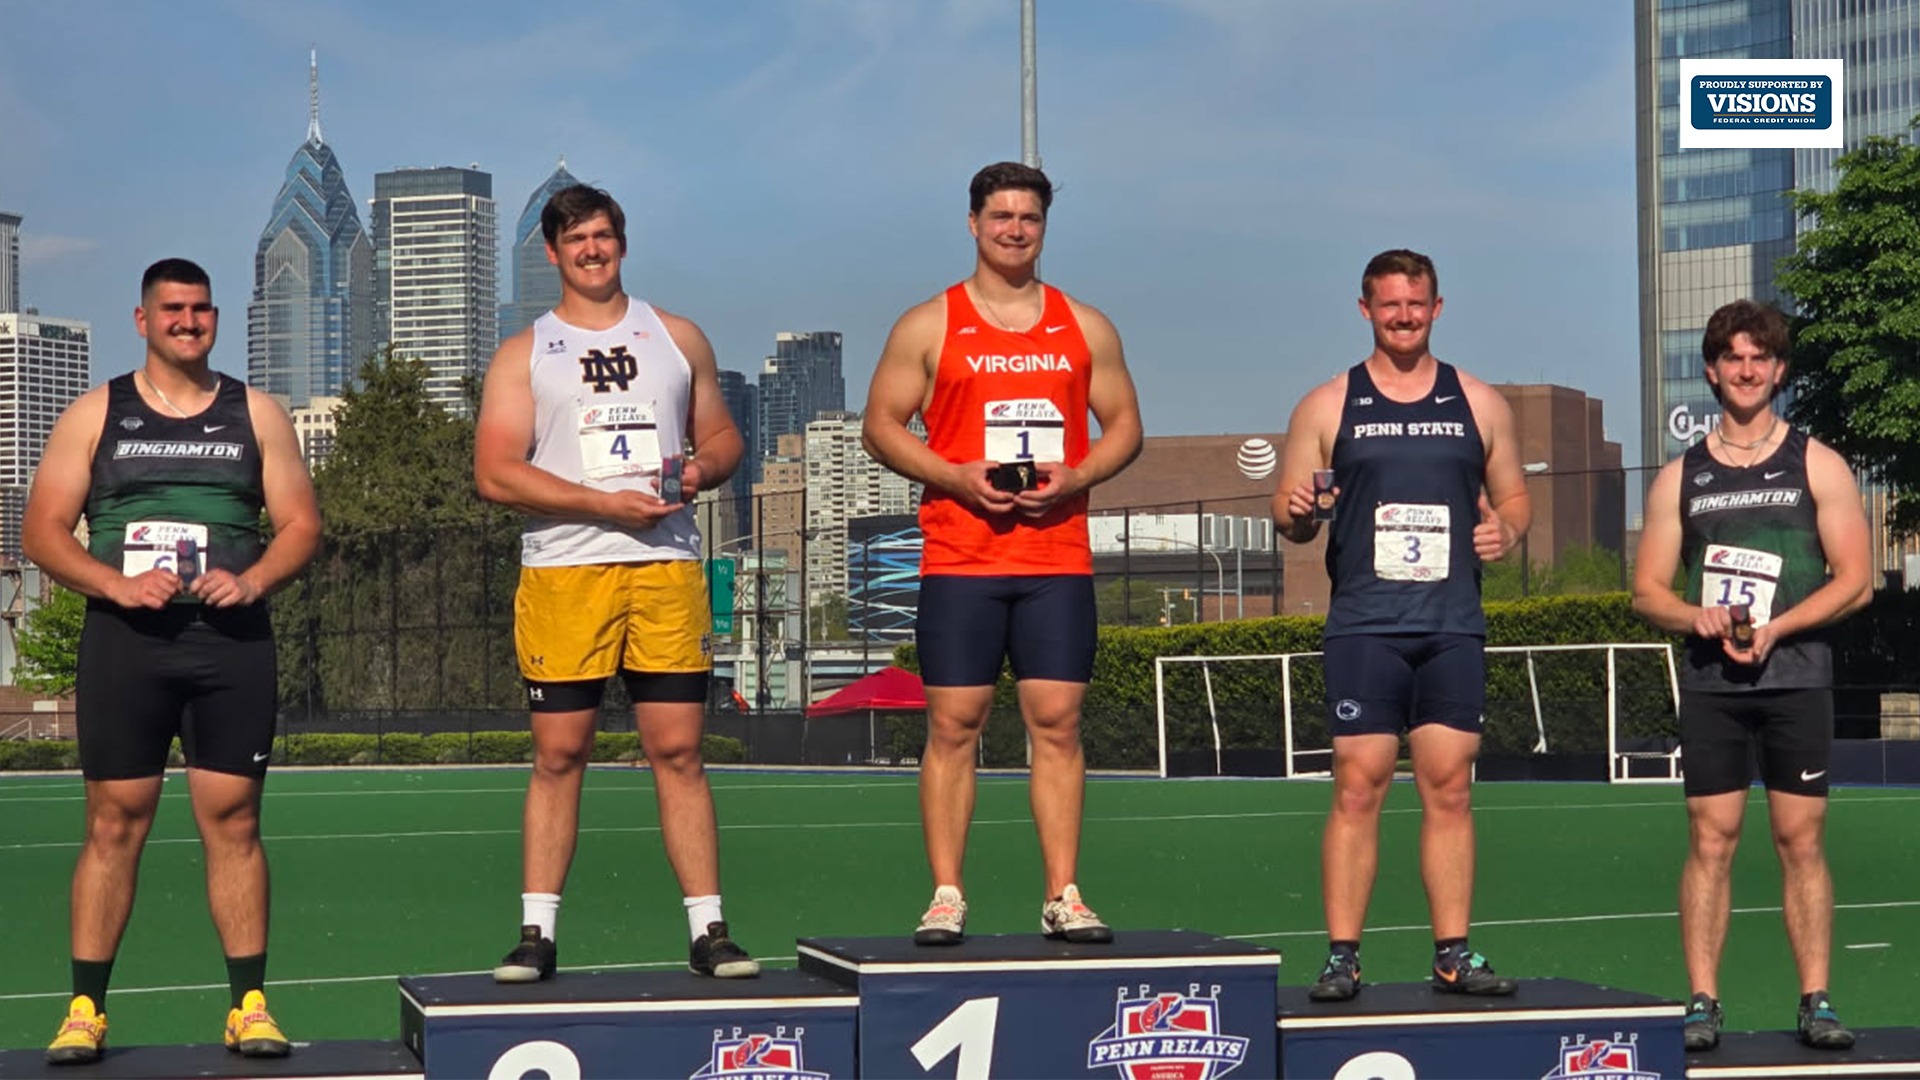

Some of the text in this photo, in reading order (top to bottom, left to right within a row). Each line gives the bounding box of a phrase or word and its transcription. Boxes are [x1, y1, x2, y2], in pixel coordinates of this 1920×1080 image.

[966, 354, 1072, 373] VIRGINIA
[609, 406, 637, 414] PENN
[1354, 422, 1465, 438] PENN STATE
[118, 443, 240, 458] BINGHAMTON
[610, 434, 631, 461] 4
[1016, 430, 1034, 459] 1
[1691, 490, 1798, 513] BINGHAMTON
[1403, 535, 1421, 564] 3
[1717, 578, 1756, 609] 15
[910, 997, 999, 1080] 1
[1094, 1038, 1243, 1062] PENN RELAYS
